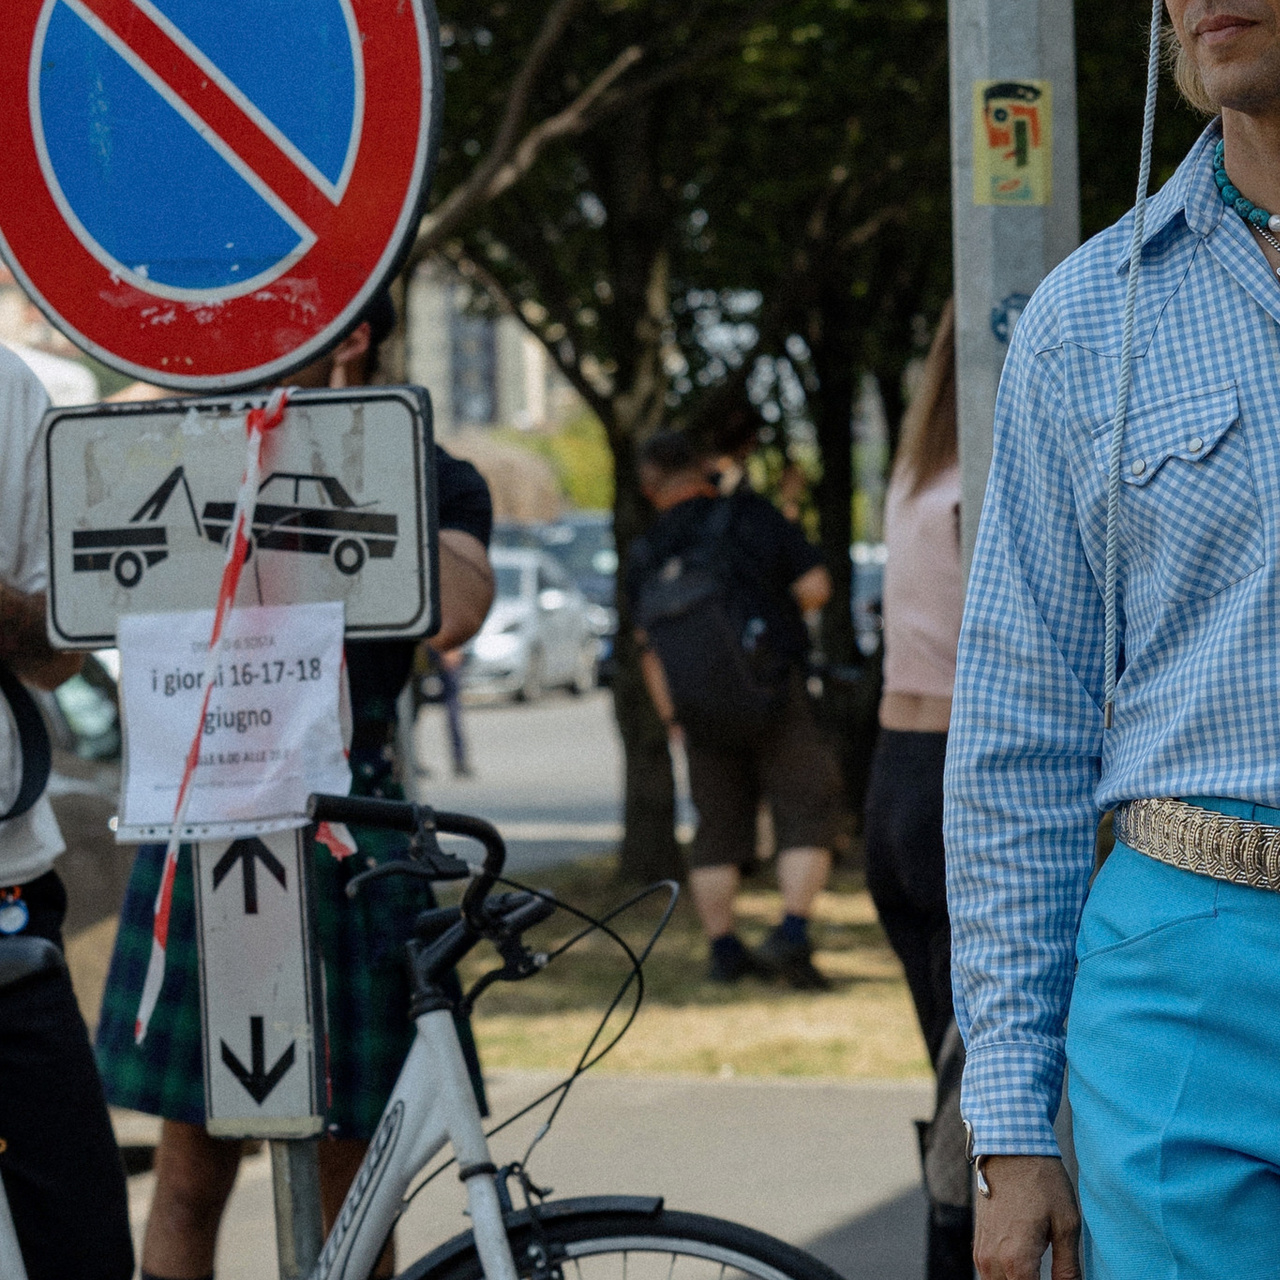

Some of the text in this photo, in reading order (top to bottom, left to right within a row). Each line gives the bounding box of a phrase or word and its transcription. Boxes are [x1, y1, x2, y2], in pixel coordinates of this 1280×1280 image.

[164, 664, 224, 697] giori
[230, 657, 322, 688] 16-17-18
[203, 706, 273, 735] giugno
